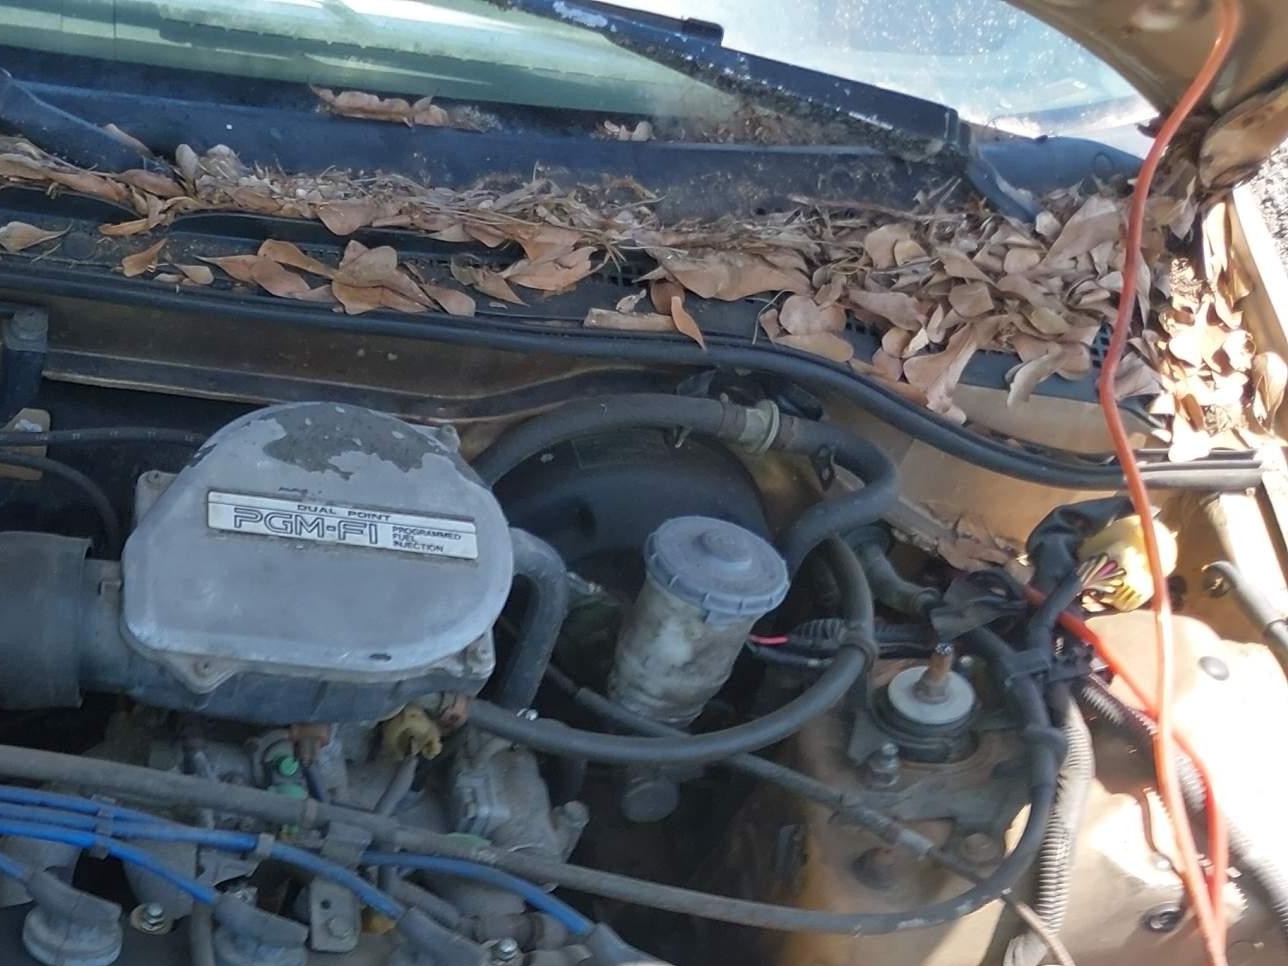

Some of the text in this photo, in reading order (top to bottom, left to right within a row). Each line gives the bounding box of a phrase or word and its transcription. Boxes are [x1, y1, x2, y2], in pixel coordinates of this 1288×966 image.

[297, 503, 392, 522] DUAL POINT
[233, 506, 379, 545] PGM-FI
[391, 525, 462, 541] PROGRAMMED
[392, 533, 416, 543] FUEL
[392, 540, 444, 553] INJECTION
